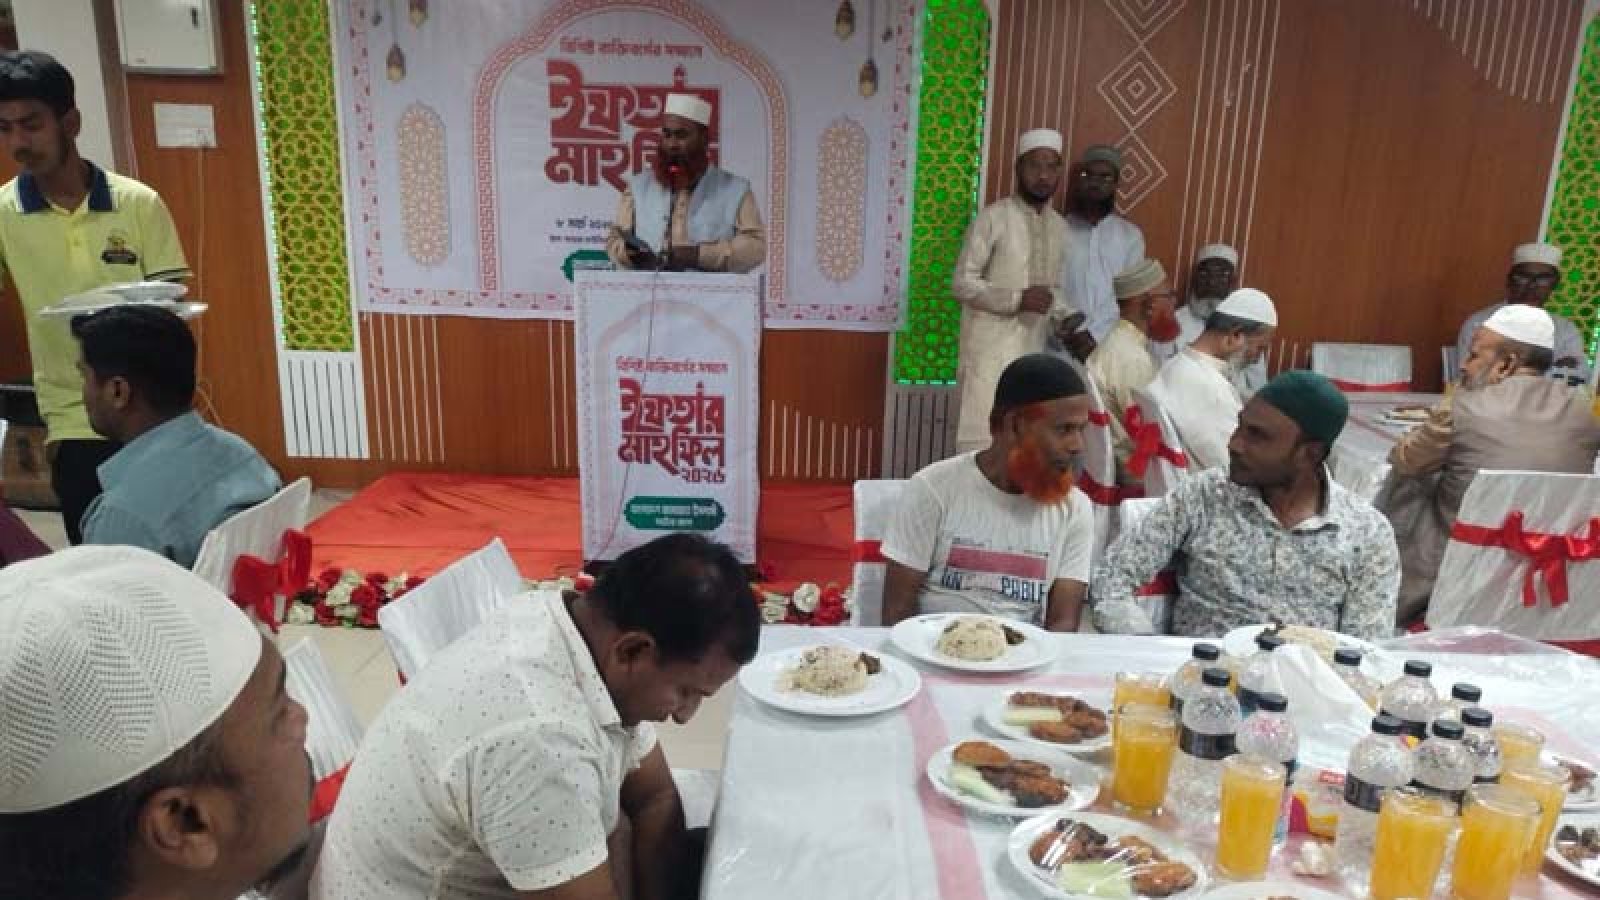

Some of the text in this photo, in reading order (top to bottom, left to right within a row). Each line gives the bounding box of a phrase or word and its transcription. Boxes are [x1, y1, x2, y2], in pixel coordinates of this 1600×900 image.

[546, 59, 720, 140] ইফত
[618, 378, 725, 434] ইফতার
[618, 427, 725, 476] মাহফিল
[681, 467, 726, 483] ২০২৬
